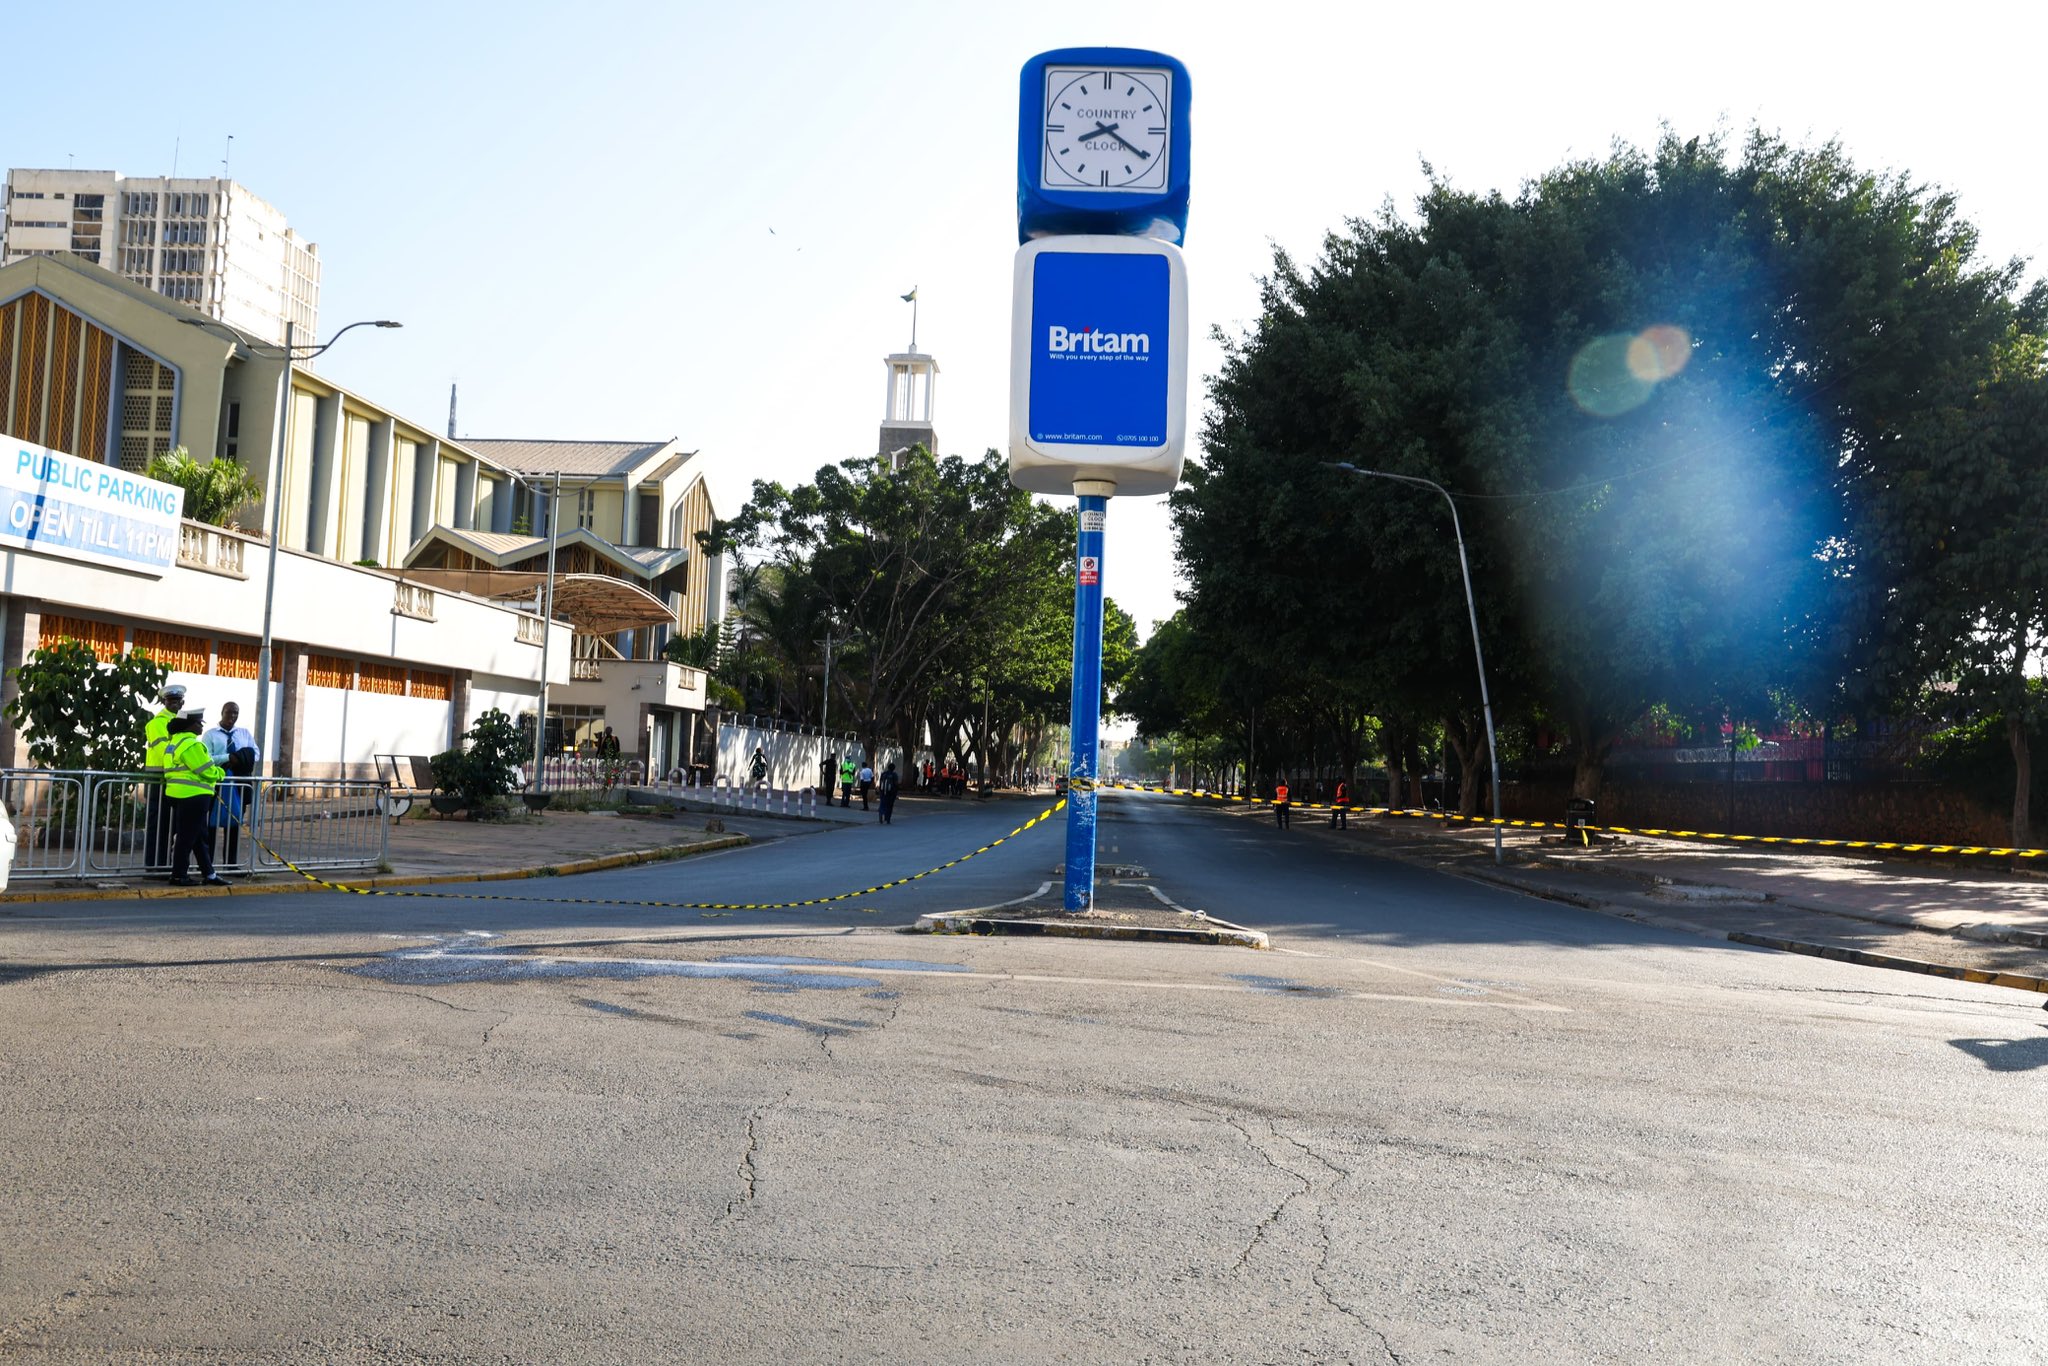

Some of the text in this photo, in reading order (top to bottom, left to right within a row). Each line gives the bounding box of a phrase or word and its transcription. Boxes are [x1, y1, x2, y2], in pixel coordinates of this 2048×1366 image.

[1077, 109, 1137, 120] COUNTRY
[1085, 142, 1127, 152] CLOCK
[1049, 326, 1149, 353] Britam
[16, 450, 176, 515] PUBLIC PARKING
[10, 500, 172, 560] OPEN TILL 11PM
